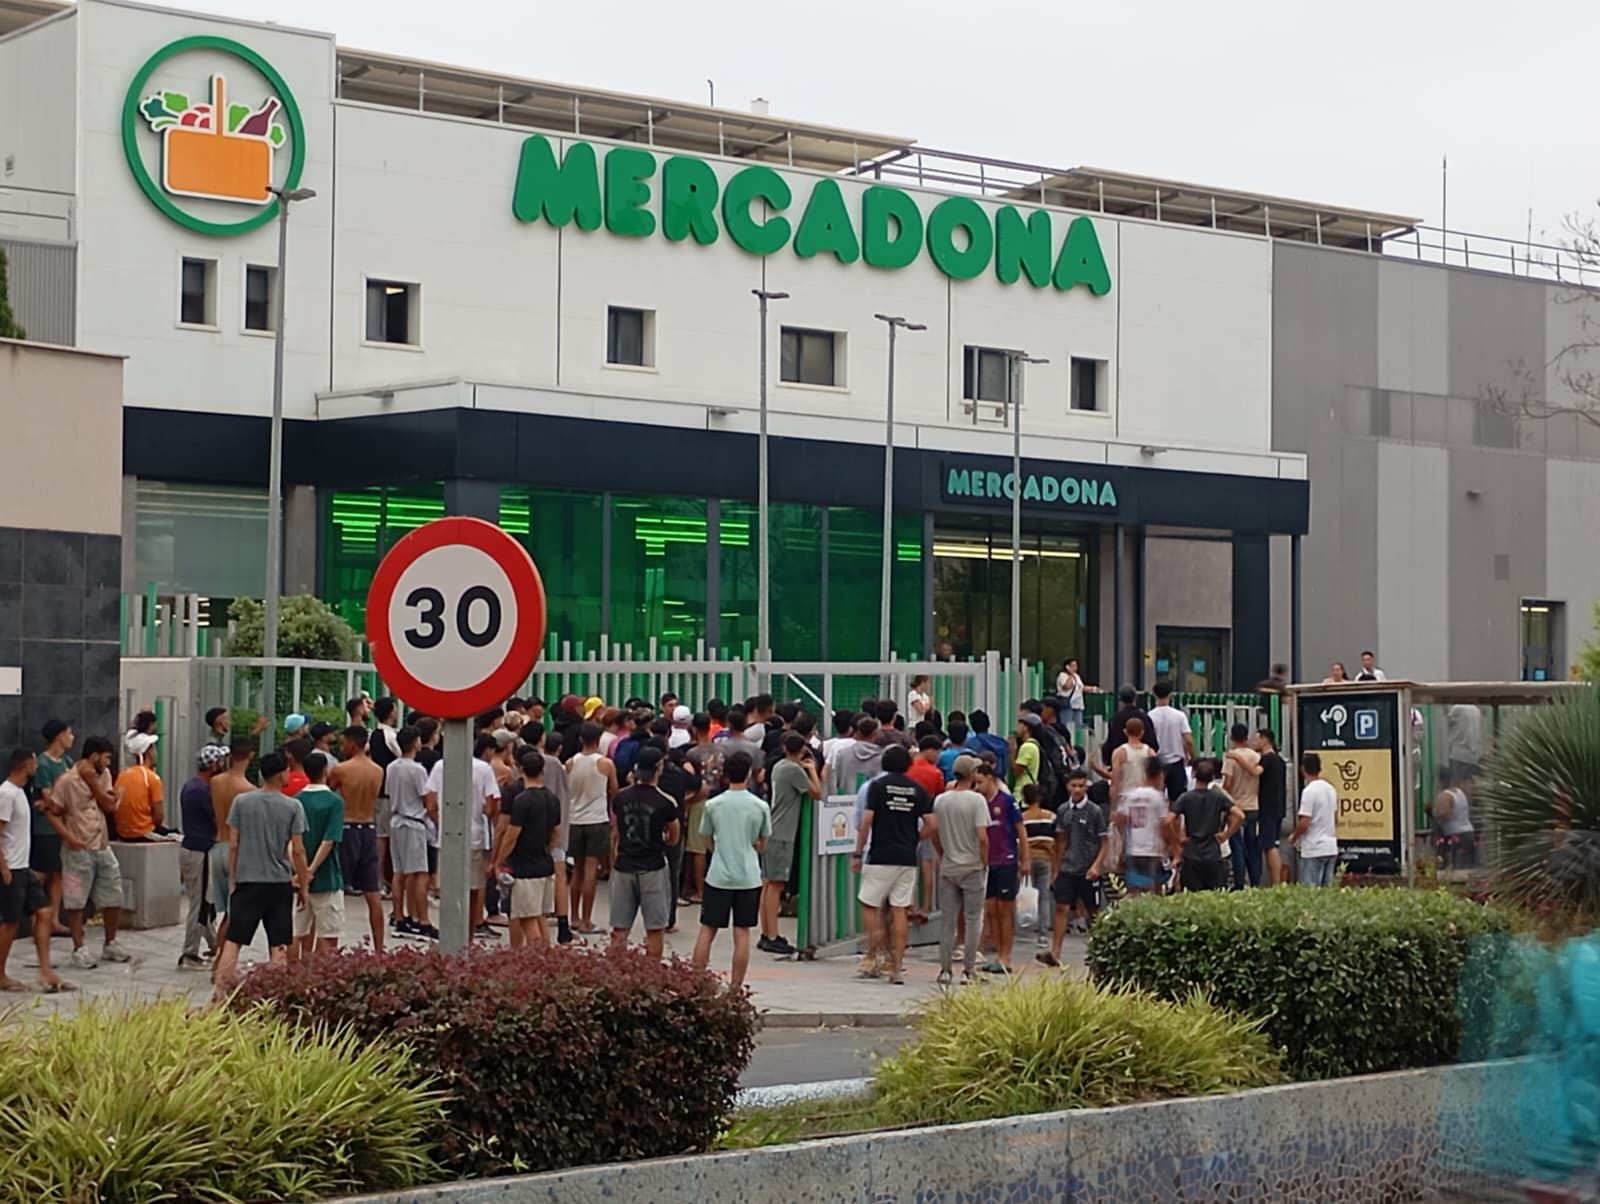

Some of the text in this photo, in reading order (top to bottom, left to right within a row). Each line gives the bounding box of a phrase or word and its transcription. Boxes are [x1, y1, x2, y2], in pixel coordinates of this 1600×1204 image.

[512, 134, 1112, 296] MERCADONA
[947, 468, 1118, 507] MERCADONA
[404, 585, 502, 649] 30
[1359, 714, 1374, 735] P
